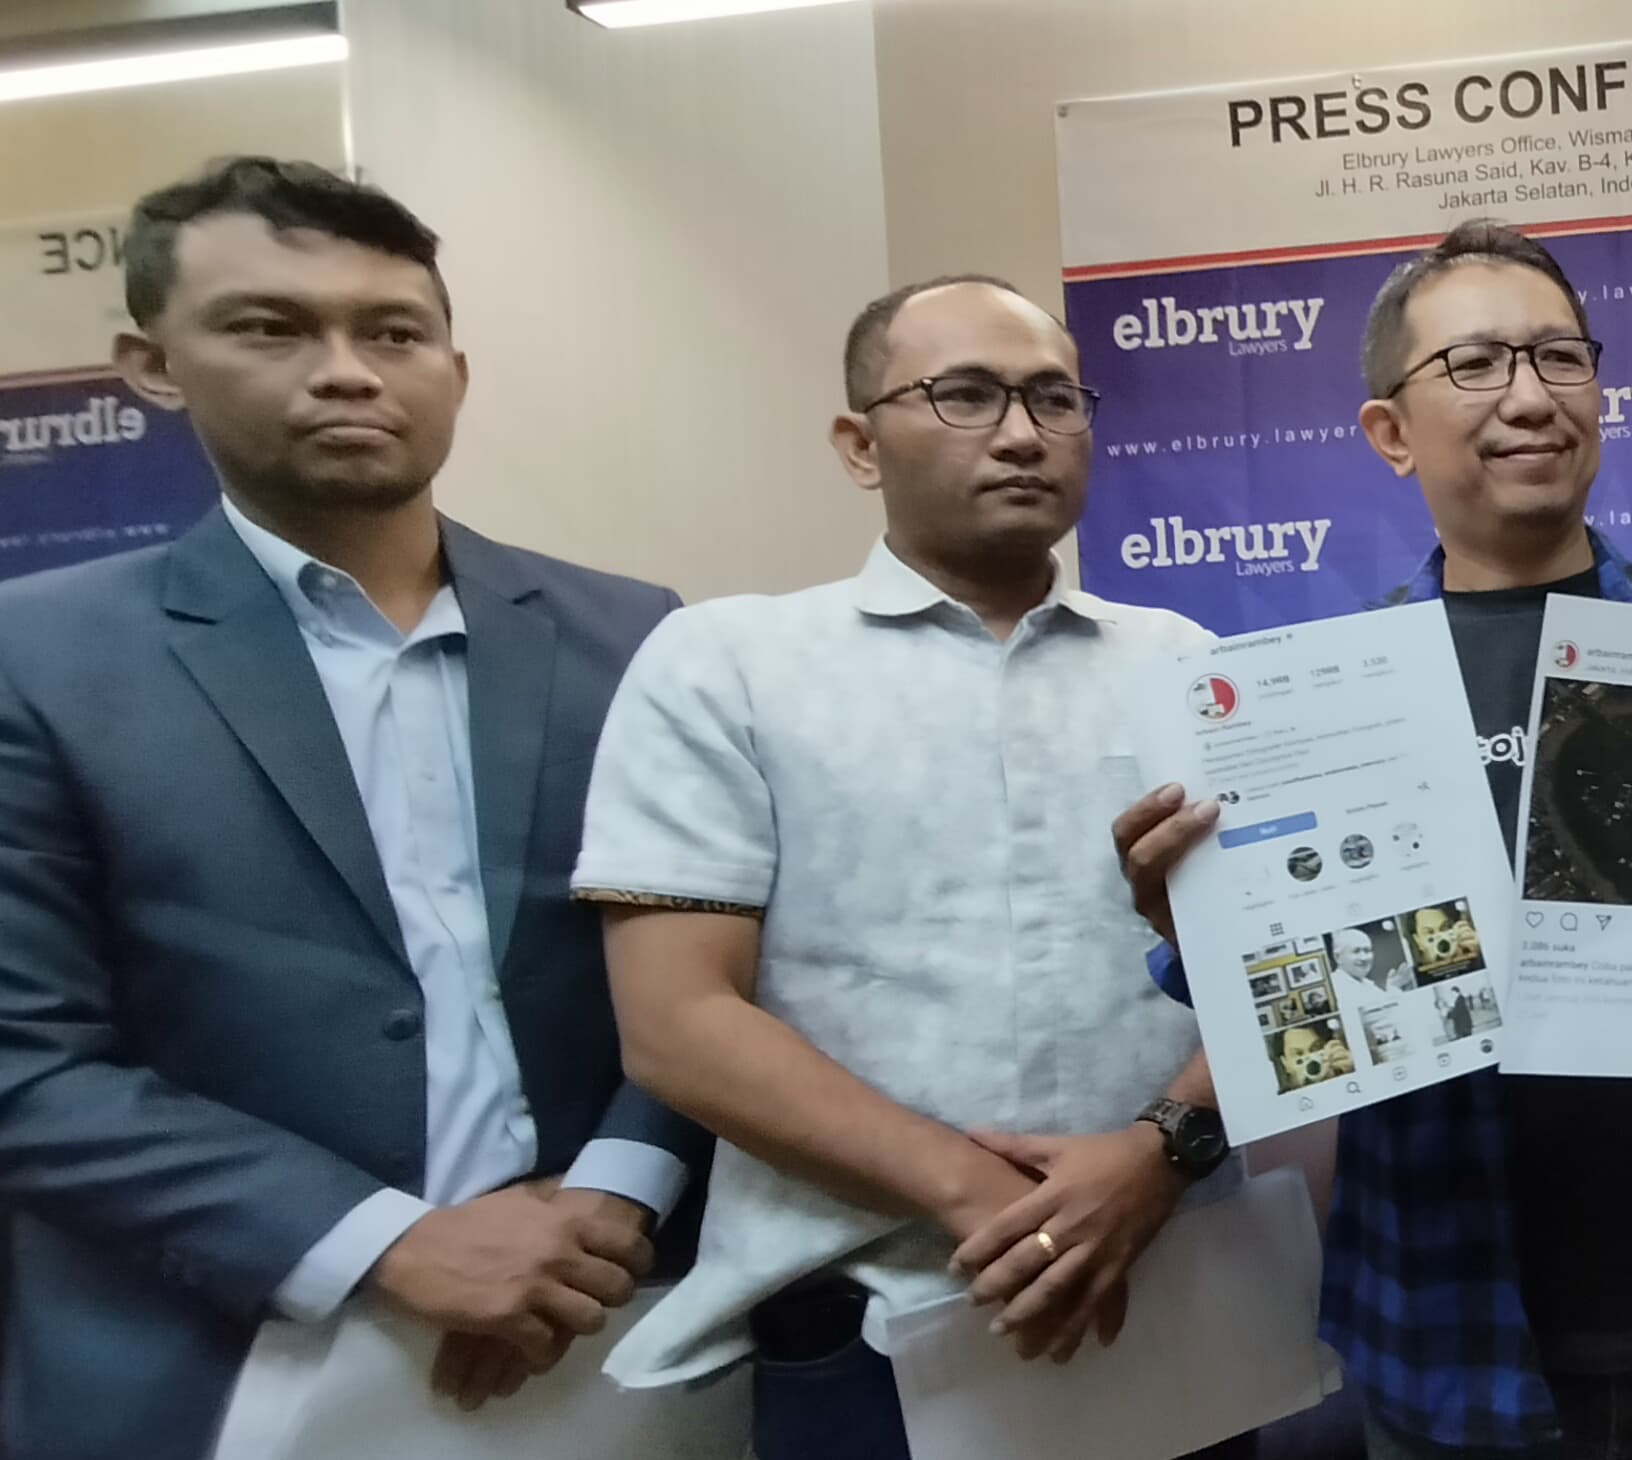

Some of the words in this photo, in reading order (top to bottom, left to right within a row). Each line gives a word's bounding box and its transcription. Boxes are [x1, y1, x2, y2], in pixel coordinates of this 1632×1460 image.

[1226, 81, 1433, 149] PRESS
[1341, 151, 1408, 172] Elbrury
[1414, 139, 1495, 165] Lawyers
[1500, 135, 1562, 156] Office,
[1341, 176, 1360, 195] H.
[1368, 173, 1389, 193] R.
[1395, 168, 1469, 189] Rasuna
[1474, 162, 1522, 184] Said,
[1529, 157, 1571, 178] Kav.
[1579, 152, 1618, 174] B-4,
[1437, 189, 1508, 210] Jakarta
[1513, 180, 1593, 202] Selatan,
[1113, 296, 1324, 351] elbrury
[1228, 339, 1288, 357] Lawyers
[1106, 424, 1359, 458] www.elbrury.lawyer
[1121, 515, 1332, 572] elbrury
[1235, 558, 1295, 577] Lawyers
